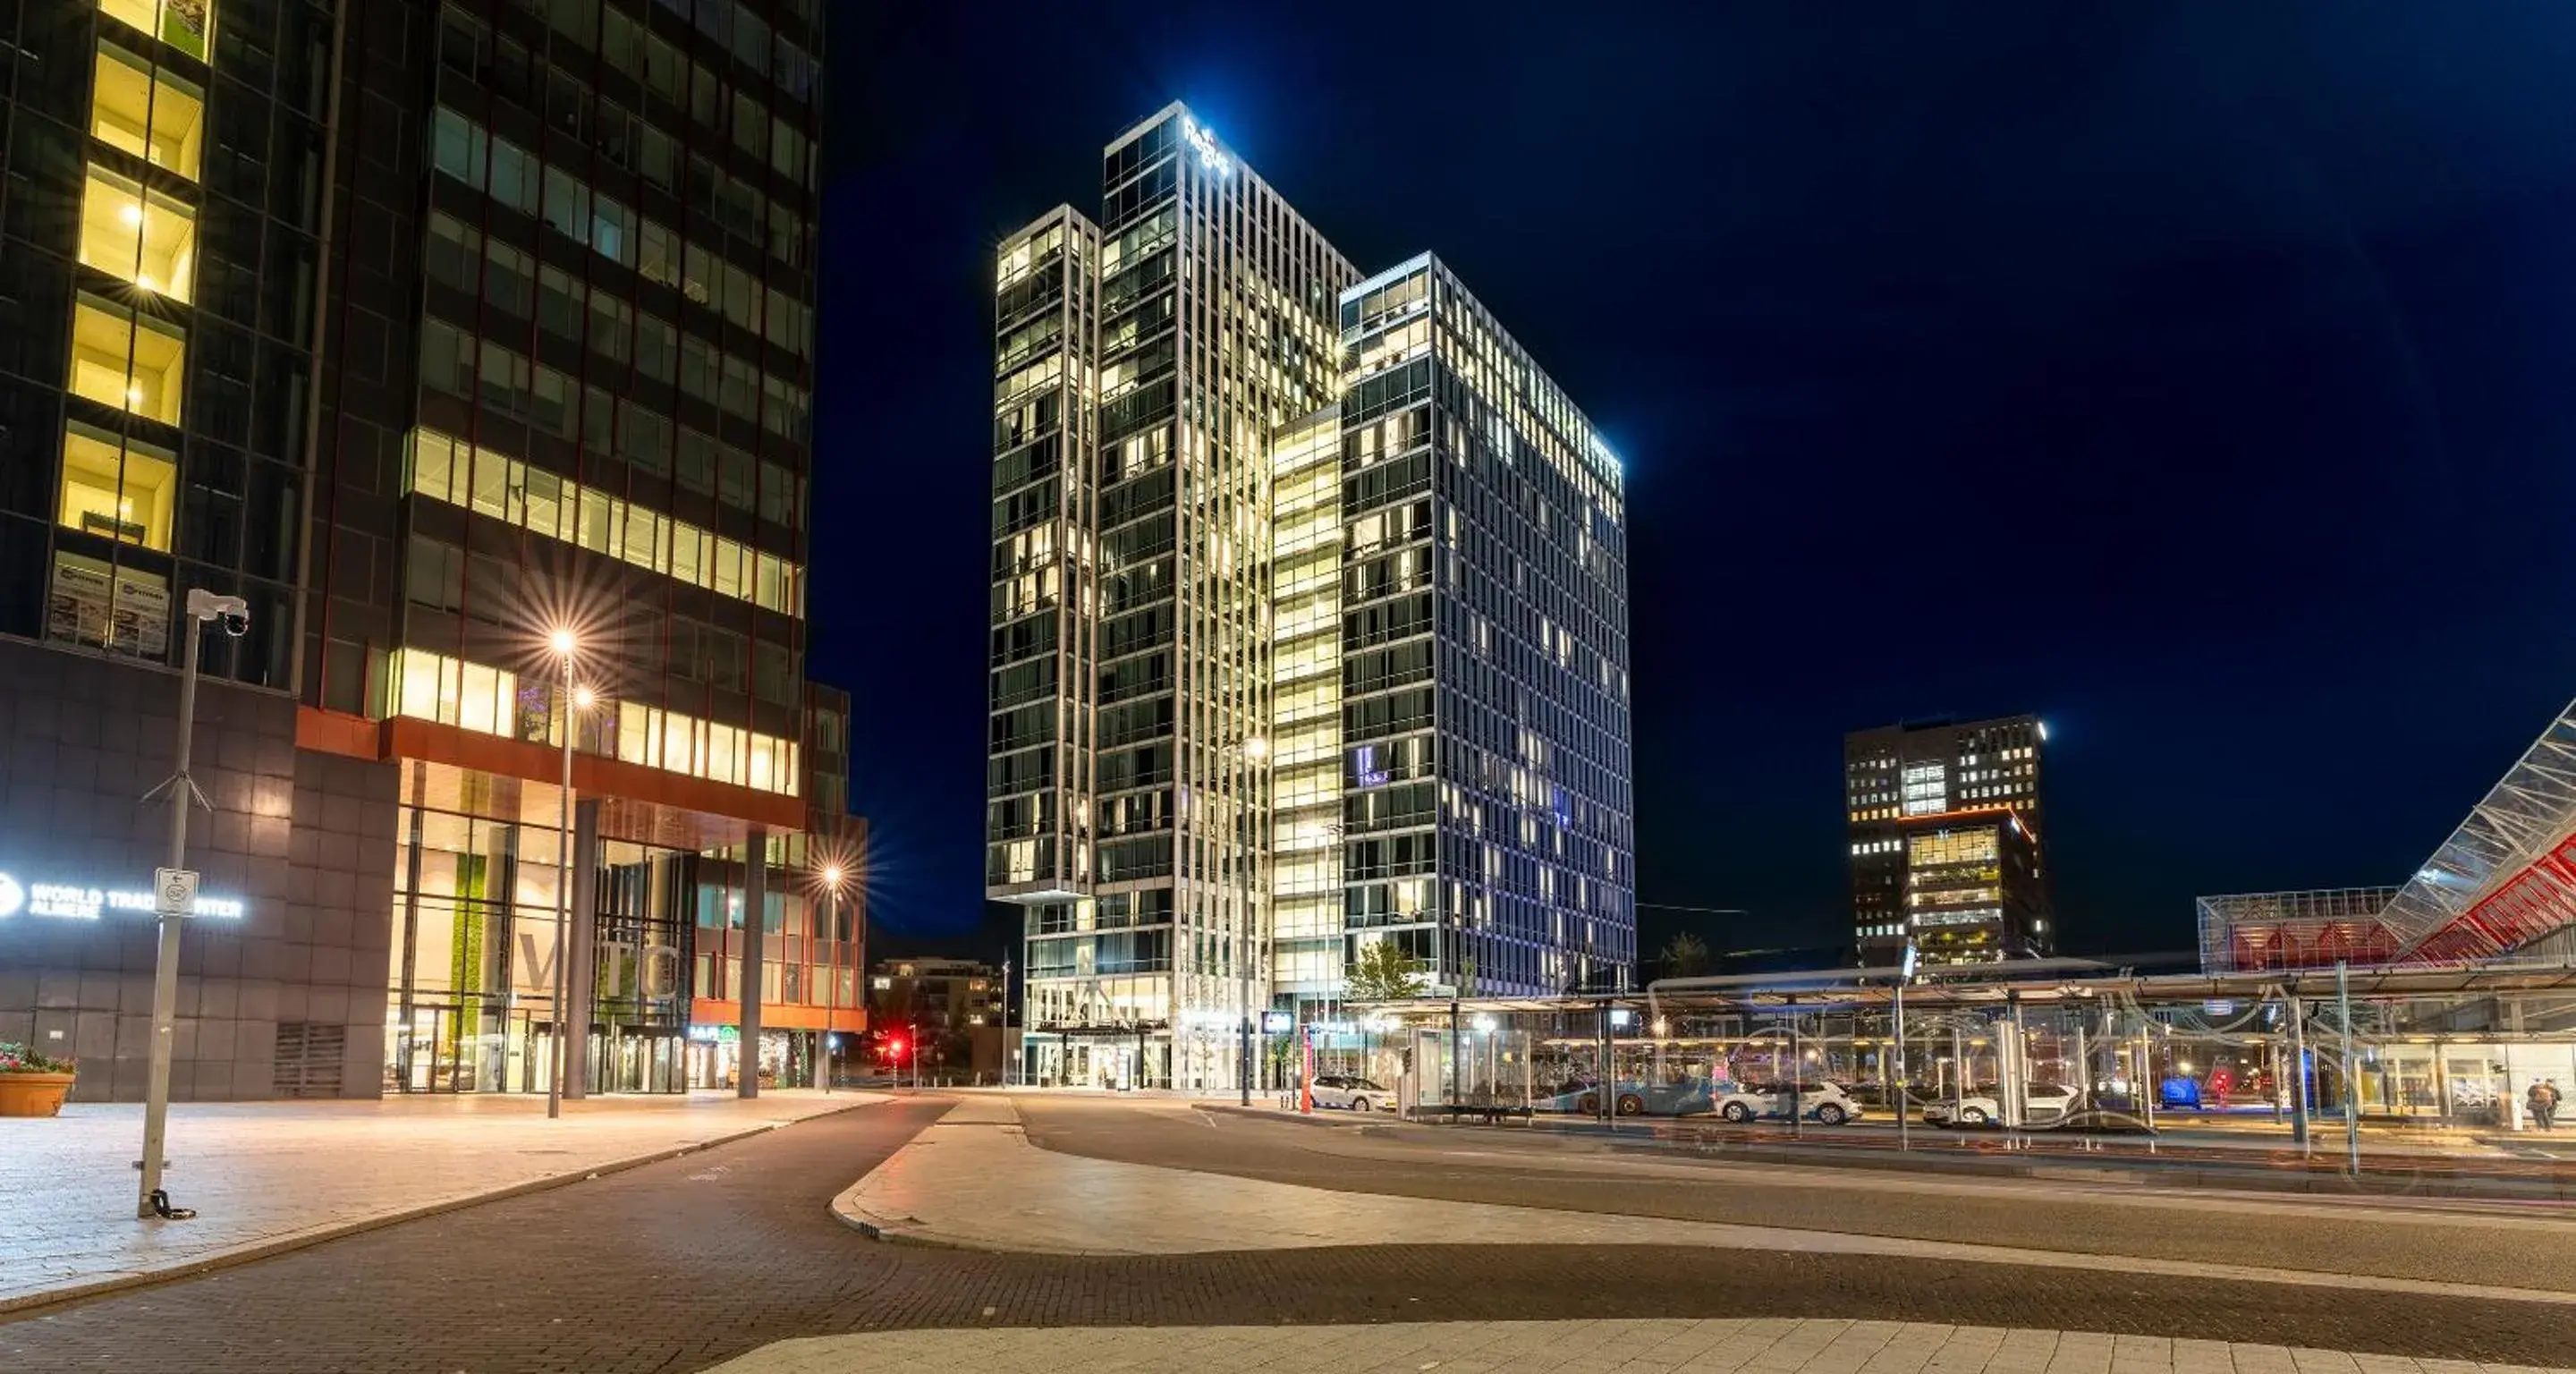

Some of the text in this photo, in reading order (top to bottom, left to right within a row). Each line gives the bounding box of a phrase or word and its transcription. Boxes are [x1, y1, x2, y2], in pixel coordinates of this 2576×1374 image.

[32, 884, 103, 904] WORLD
[107, 890, 156, 910] TRAD
[30, 900, 100, 919] ALMERE
